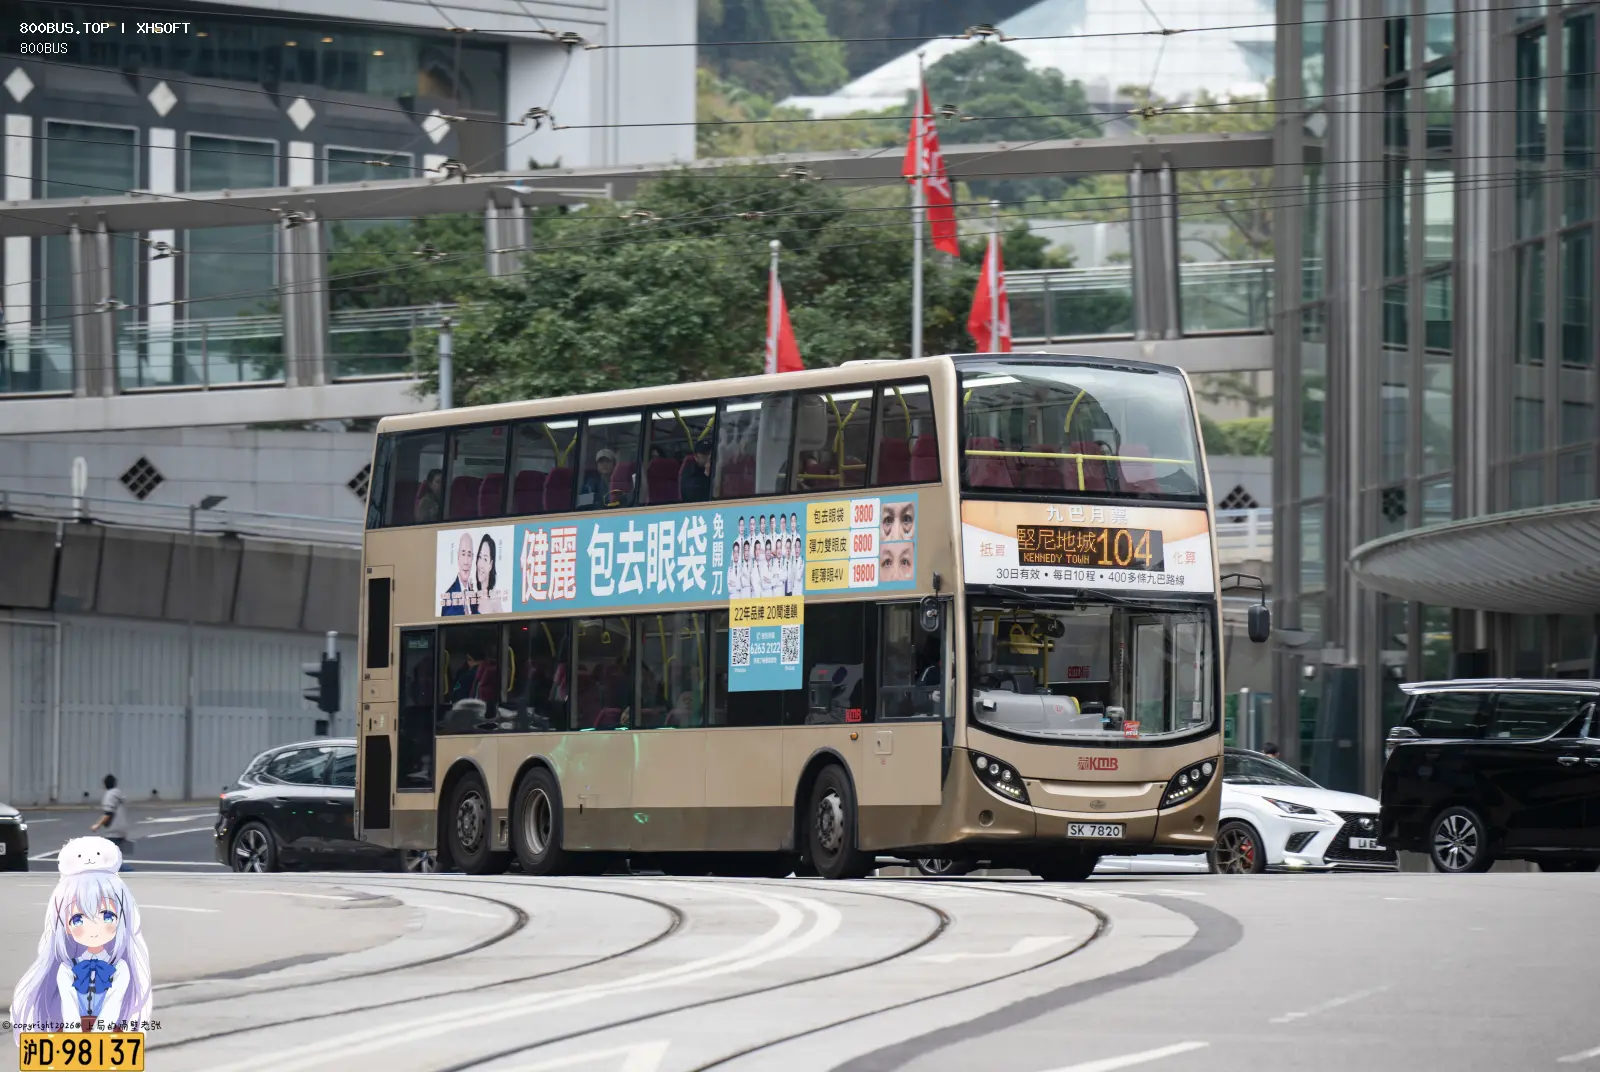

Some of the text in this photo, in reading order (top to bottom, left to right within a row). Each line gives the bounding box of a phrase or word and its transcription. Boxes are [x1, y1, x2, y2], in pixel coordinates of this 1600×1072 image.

[813, 508, 844, 524] 包去眼袋
[854, 504, 874, 523] 3800
[1046, 505, 1129, 524] 九巴月票
[853, 534, 873, 552] 6800
[1017, 528, 1097, 553] 堅尼地城
[1097, 528, 1153, 566] 104
[520, 515, 708, 604] 健麗 包去眼袋
[711, 512, 725, 596] 免開刀
[1023, 552, 1090, 565] KENNEDY TOWN
[852, 563, 875, 582] 19800
[734, 606, 765, 621] 22年品牌
[750, 642, 766, 655] 6263
[1089, 757, 1119, 771] KMB
[1070, 824, 1120, 837] SK 7820
